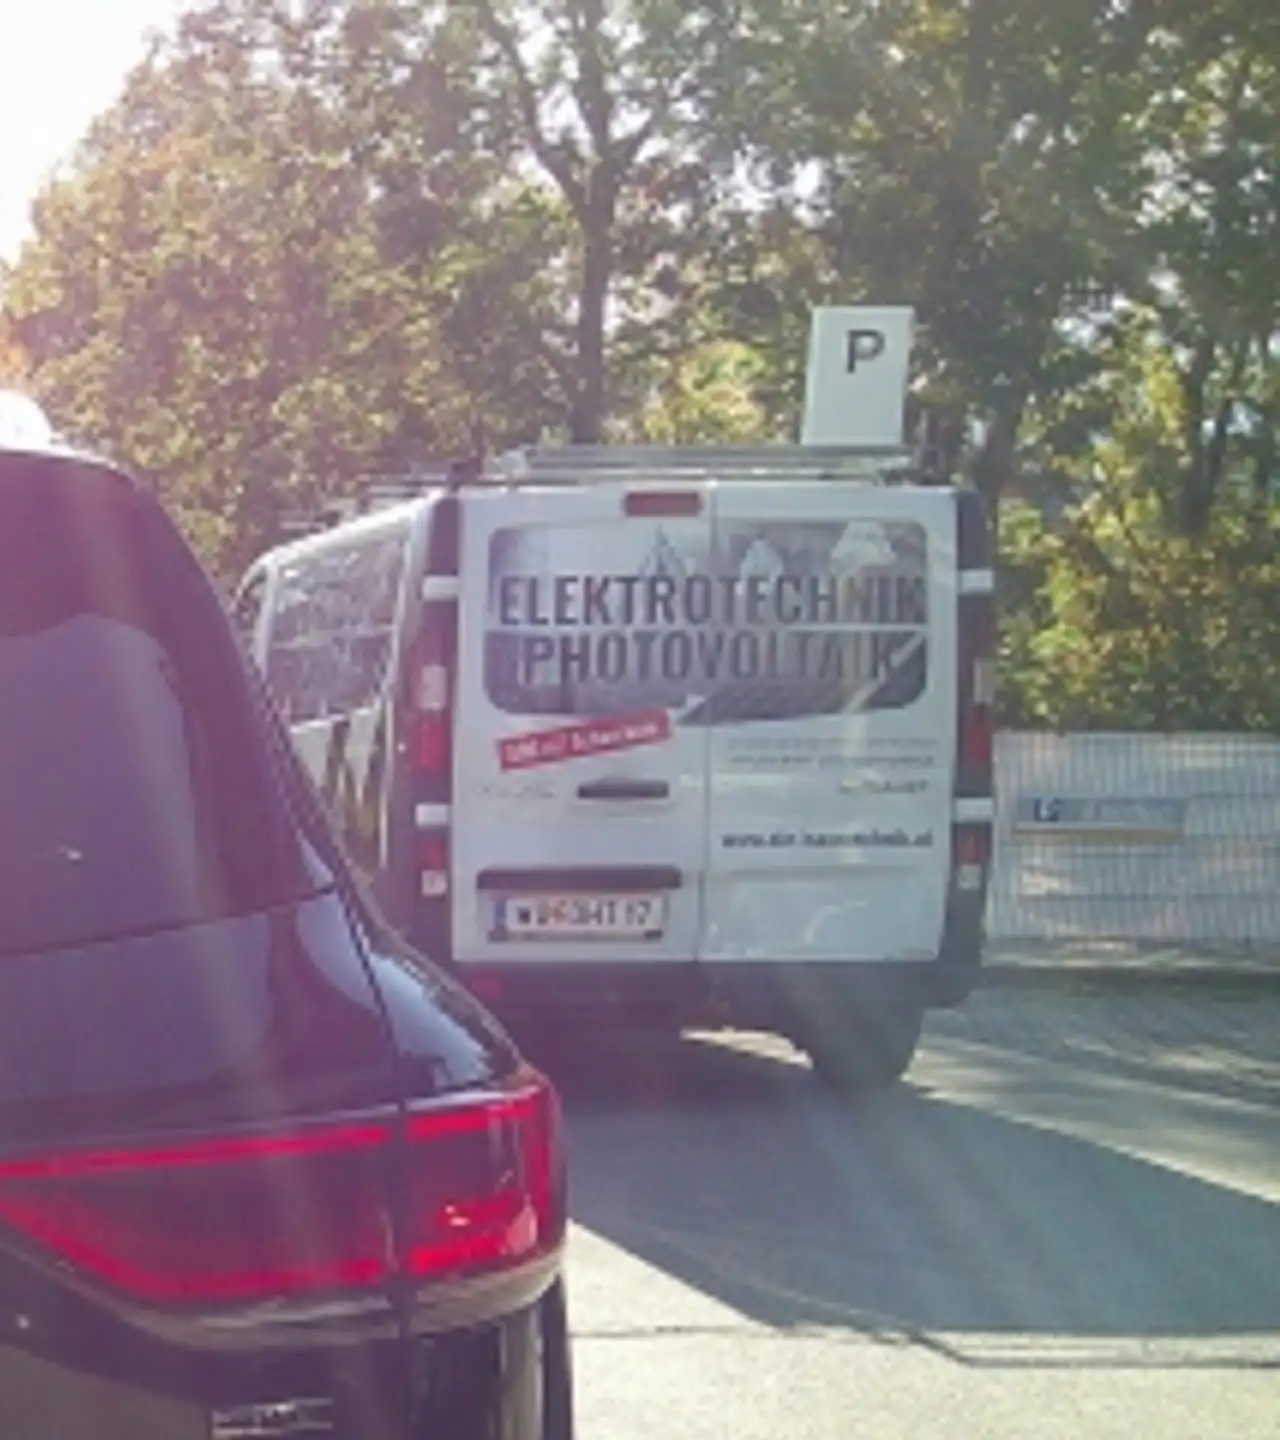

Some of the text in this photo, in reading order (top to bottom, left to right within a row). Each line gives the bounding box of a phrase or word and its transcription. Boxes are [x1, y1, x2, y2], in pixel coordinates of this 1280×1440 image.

[847, 329, 886, 374] P
[498, 573, 926, 627] ELEKTROTECHNIK
[522, 631, 896, 686] PHOTOVOLTAIK
